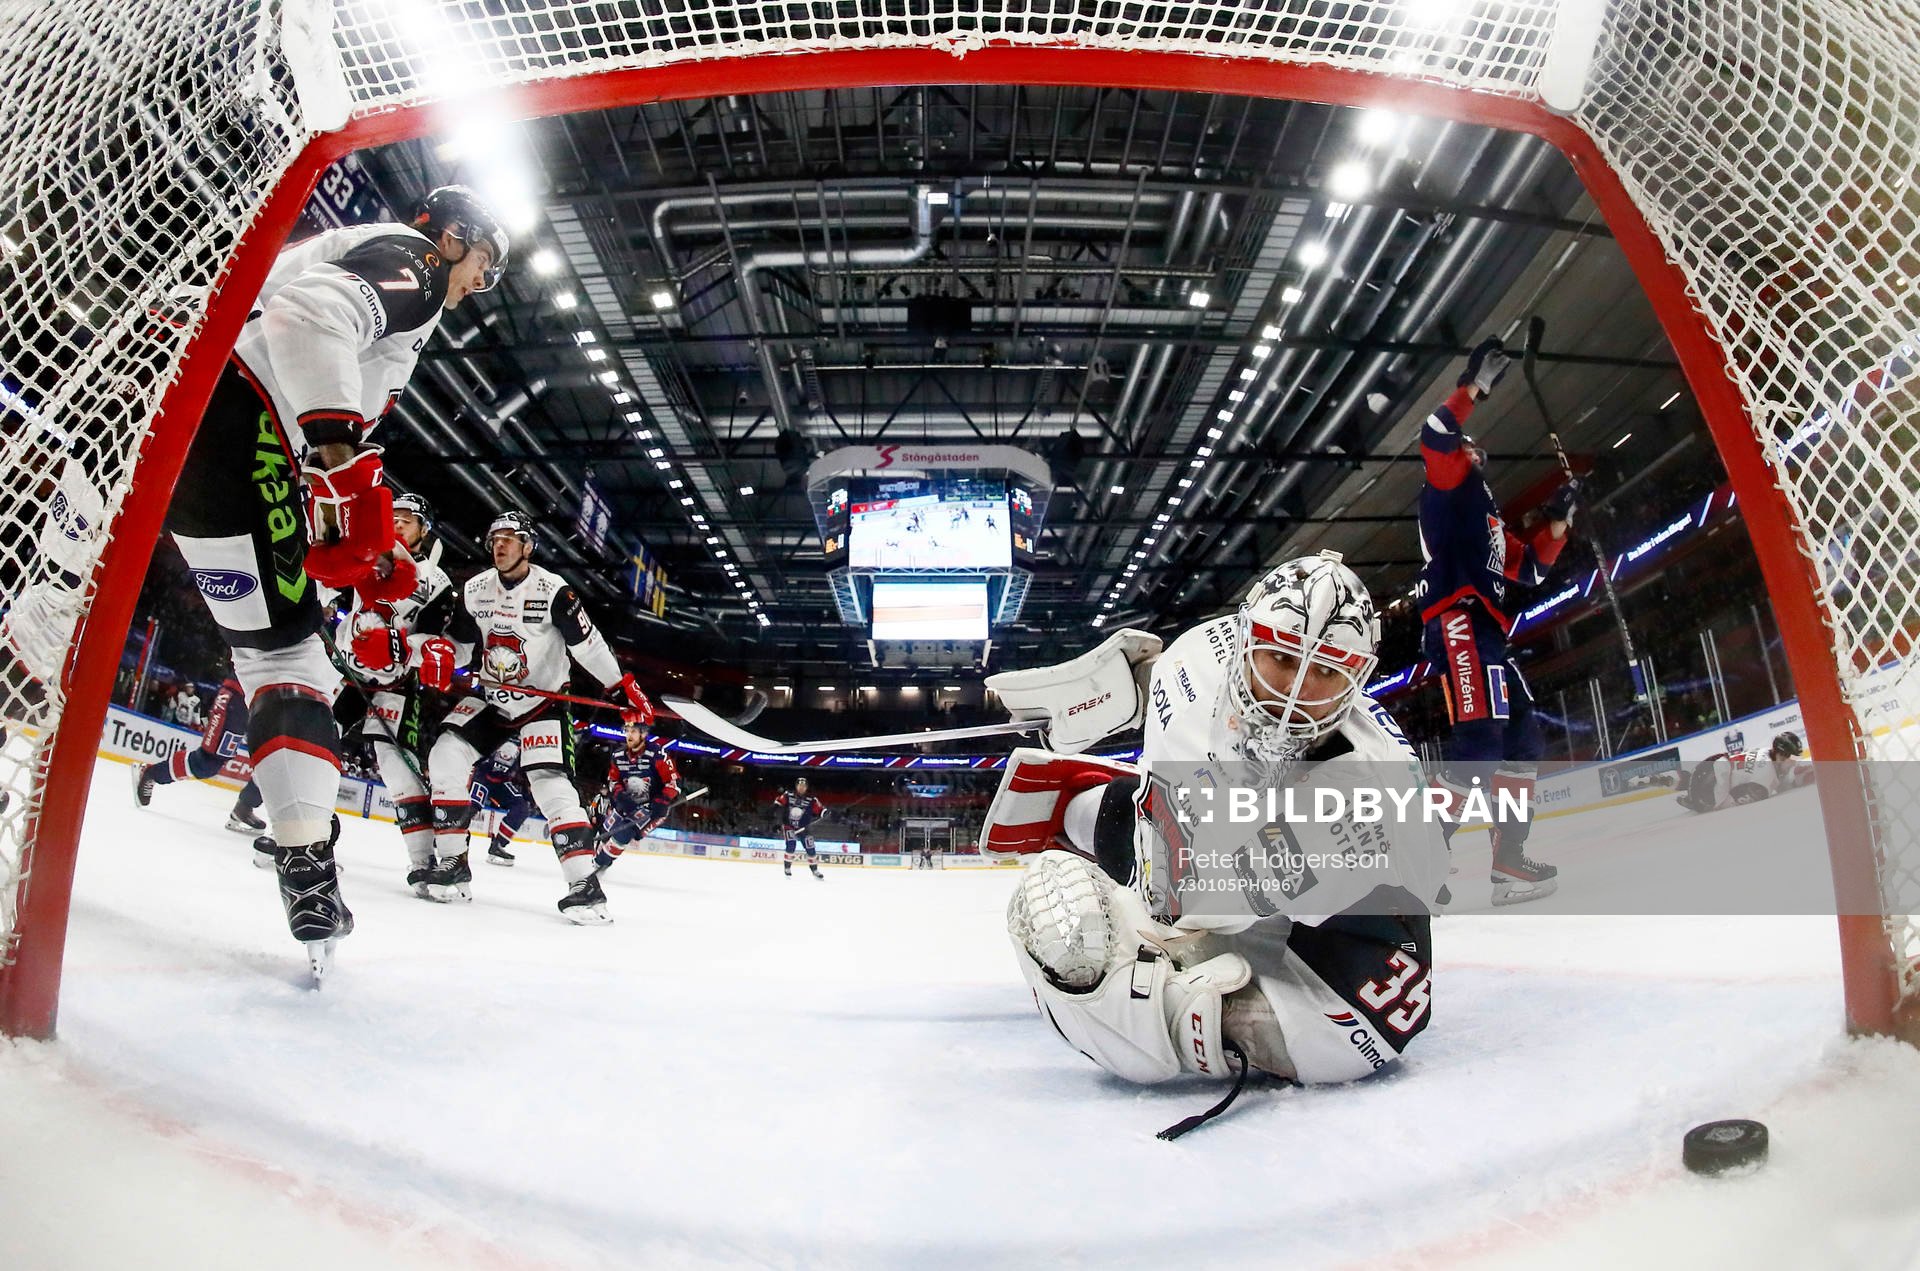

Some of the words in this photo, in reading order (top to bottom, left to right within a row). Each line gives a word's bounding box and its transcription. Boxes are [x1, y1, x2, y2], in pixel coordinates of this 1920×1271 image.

[377, 267, 420, 292] 7
[195, 572, 240, 596] Ford
[1205, 627, 1227, 665] HOTEL
[1177, 667, 1197, 703] TREANO
[1152, 678, 1174, 731] DOXA
[522, 735, 559, 749] MAXI
[1543, 786, 1572, 803] Event
[1358, 949, 1432, 1035] 35
[1191, 1012, 1213, 1076] CCM
